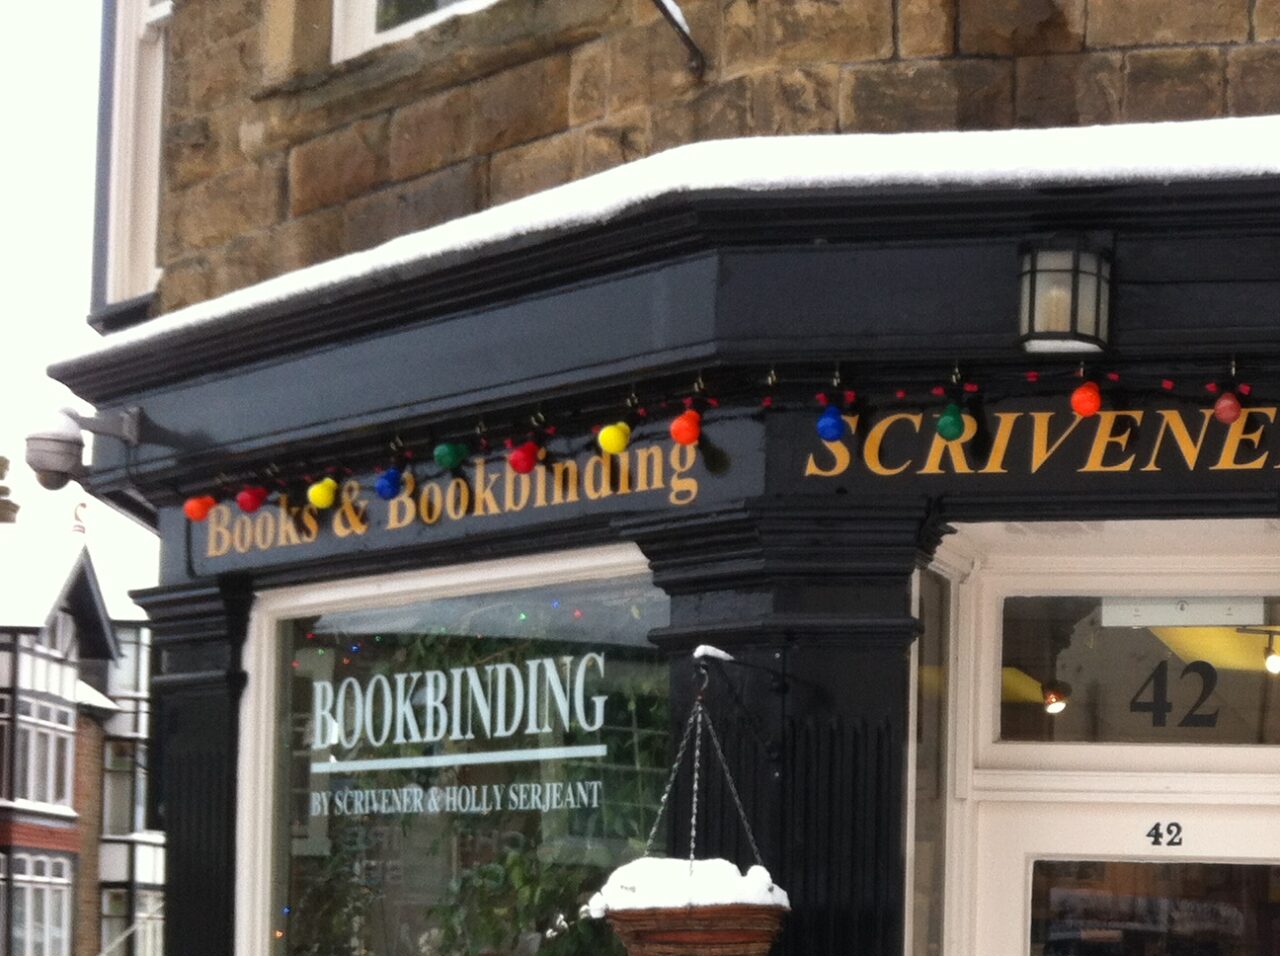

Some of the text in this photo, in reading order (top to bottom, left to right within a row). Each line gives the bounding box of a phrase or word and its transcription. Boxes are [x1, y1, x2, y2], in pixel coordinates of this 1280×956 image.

[205, 441, 700, 558] Books & Bookbinding
[311, 652, 609, 750] BOOKBINDING
[1130, 660, 1221, 728] 42
[310, 780, 603, 817] BY SCRIVENER & HOLLY SERJEANT
[1146, 822, 1184, 847] 42
